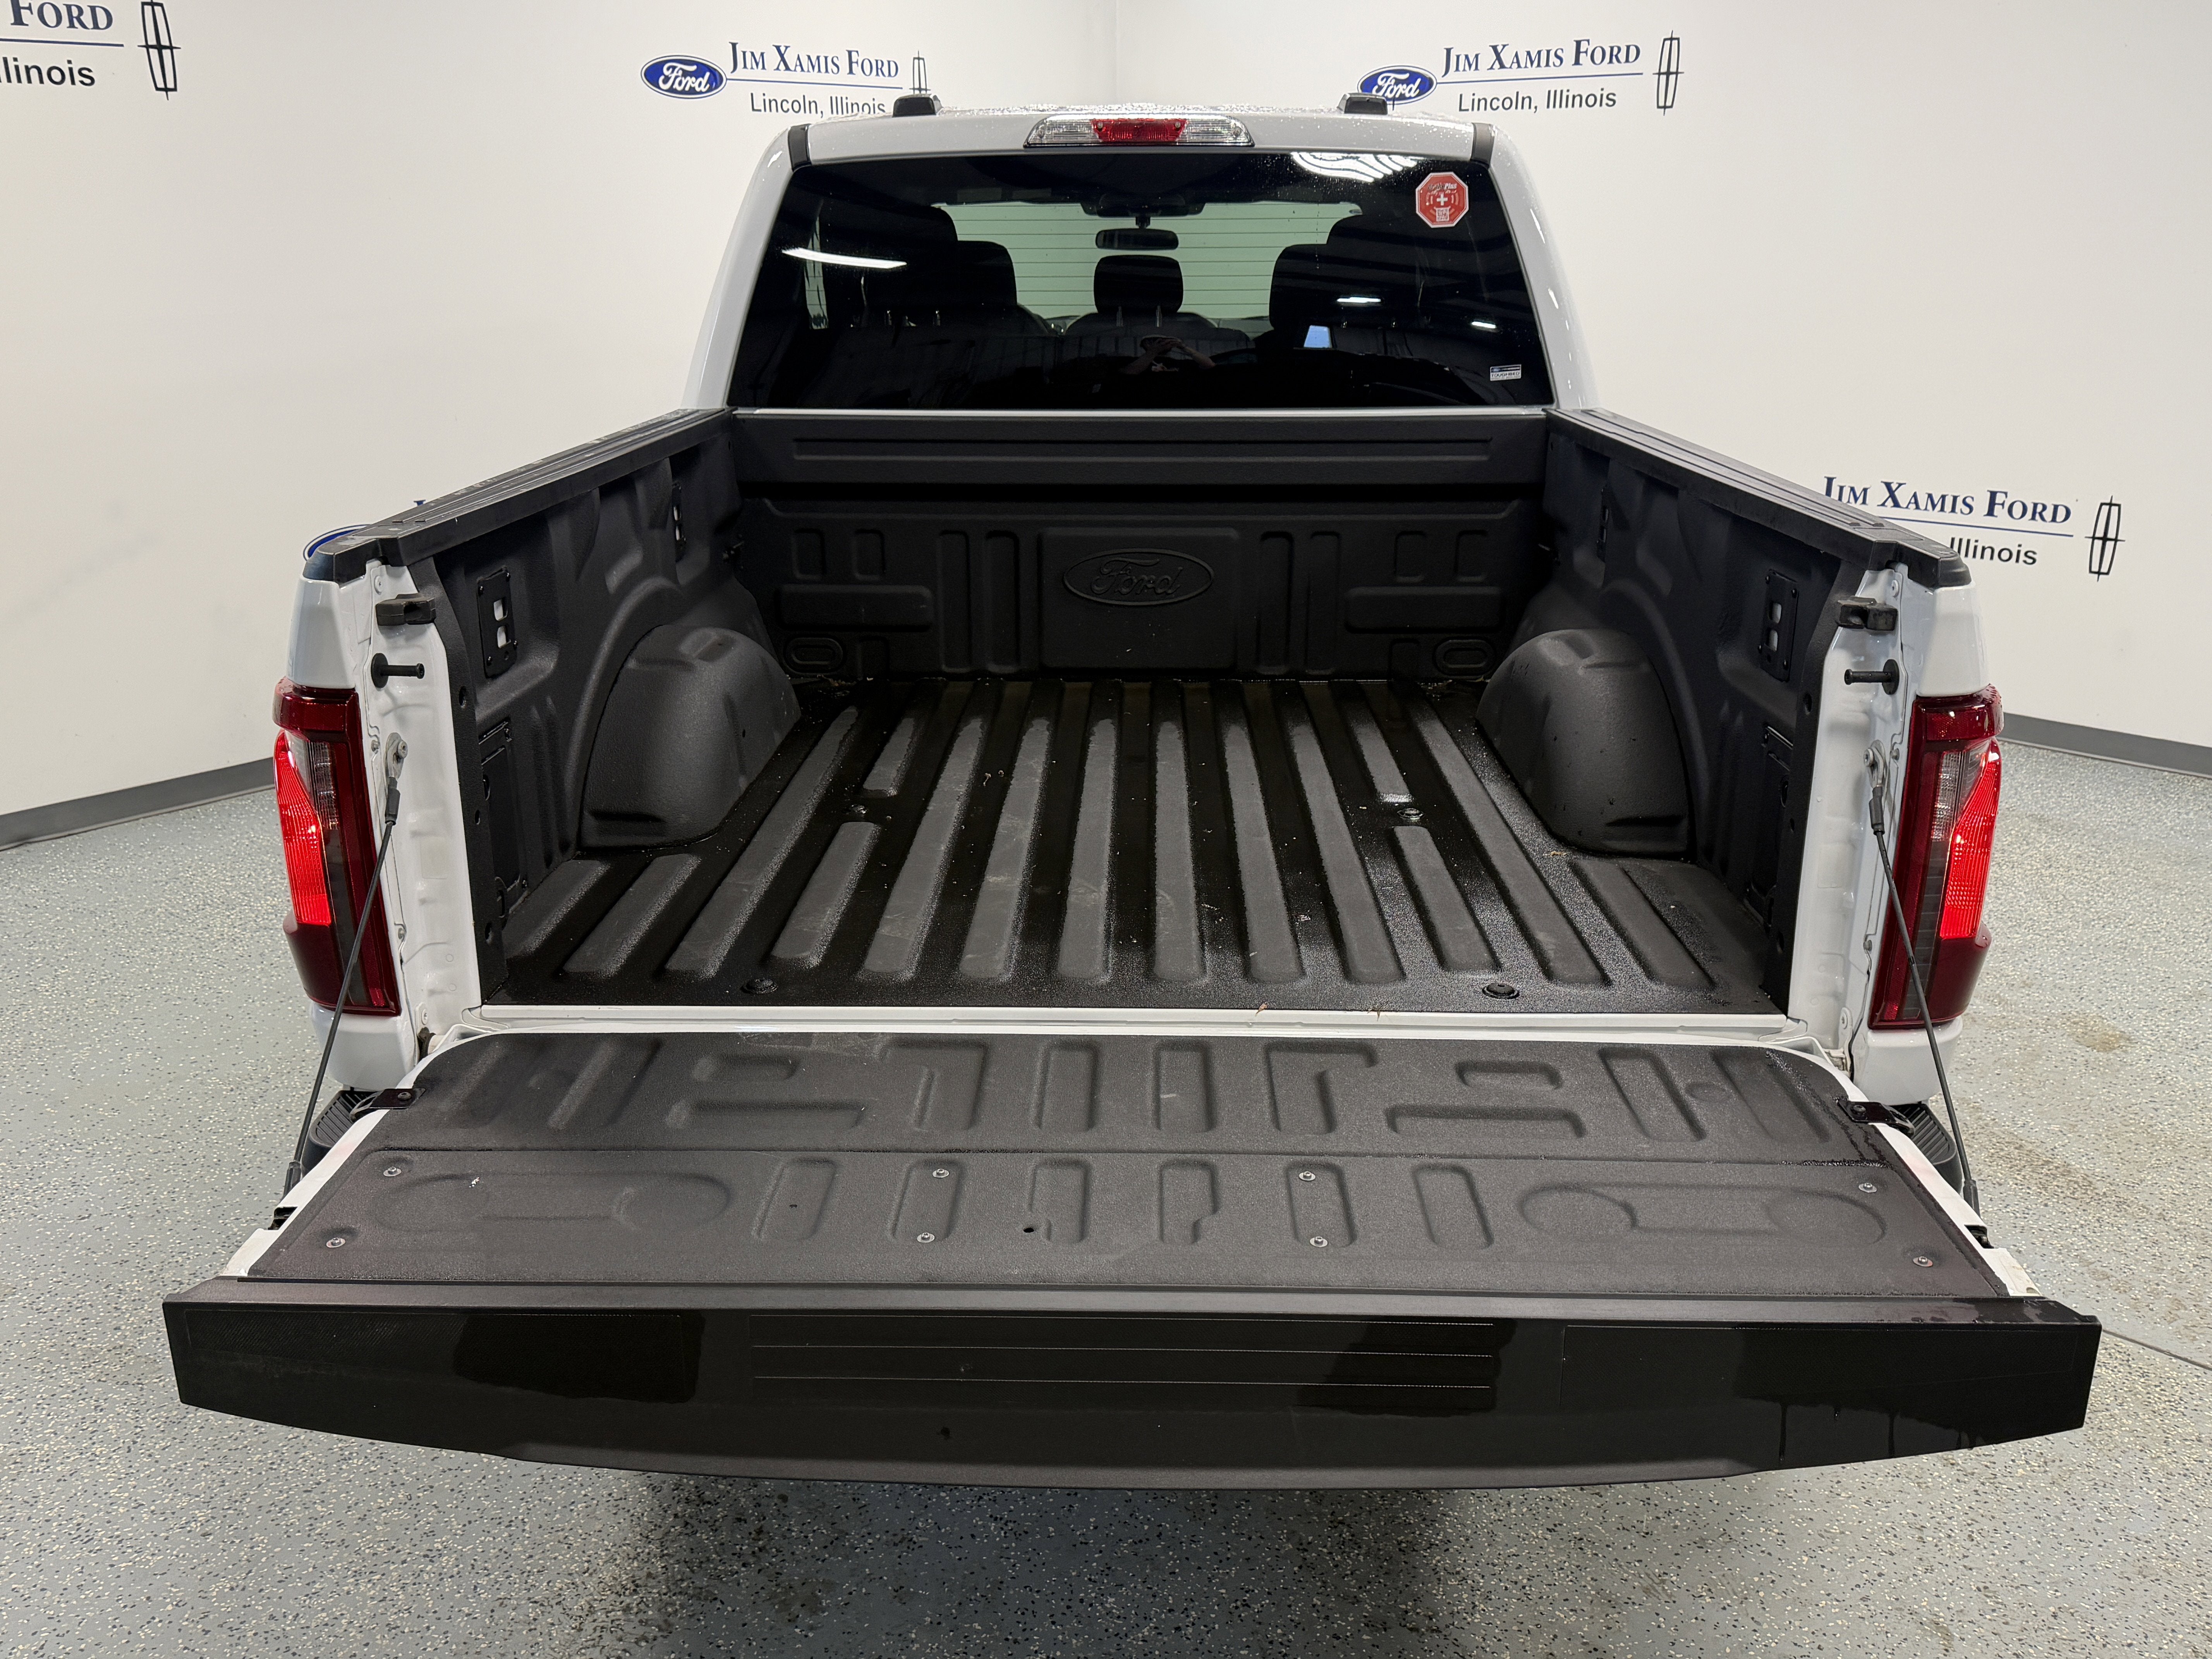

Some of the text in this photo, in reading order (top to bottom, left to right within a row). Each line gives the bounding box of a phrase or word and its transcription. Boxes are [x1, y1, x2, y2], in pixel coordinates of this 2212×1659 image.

[10, 0, 113, 30] FORD
[0, 57, 95, 86] linois
[728, 41, 899, 77] JIM XAMIS FORD
[1441, 39, 1641, 77] JIM XAMIS FORD
[659, 62, 710, 92] Ford
[1372, 72, 1422, 98] Ford
[750, 93, 886, 118] Lincoln, Illinois
[1459, 88, 1616, 113] Lincoln, Illinois
[1877, 481, 1974, 515] XAMIS
[1983, 490, 2071, 524] FORD
[1950, 537, 2037, 565] Illinois
[1090, 556, 1183, 596] Ford
